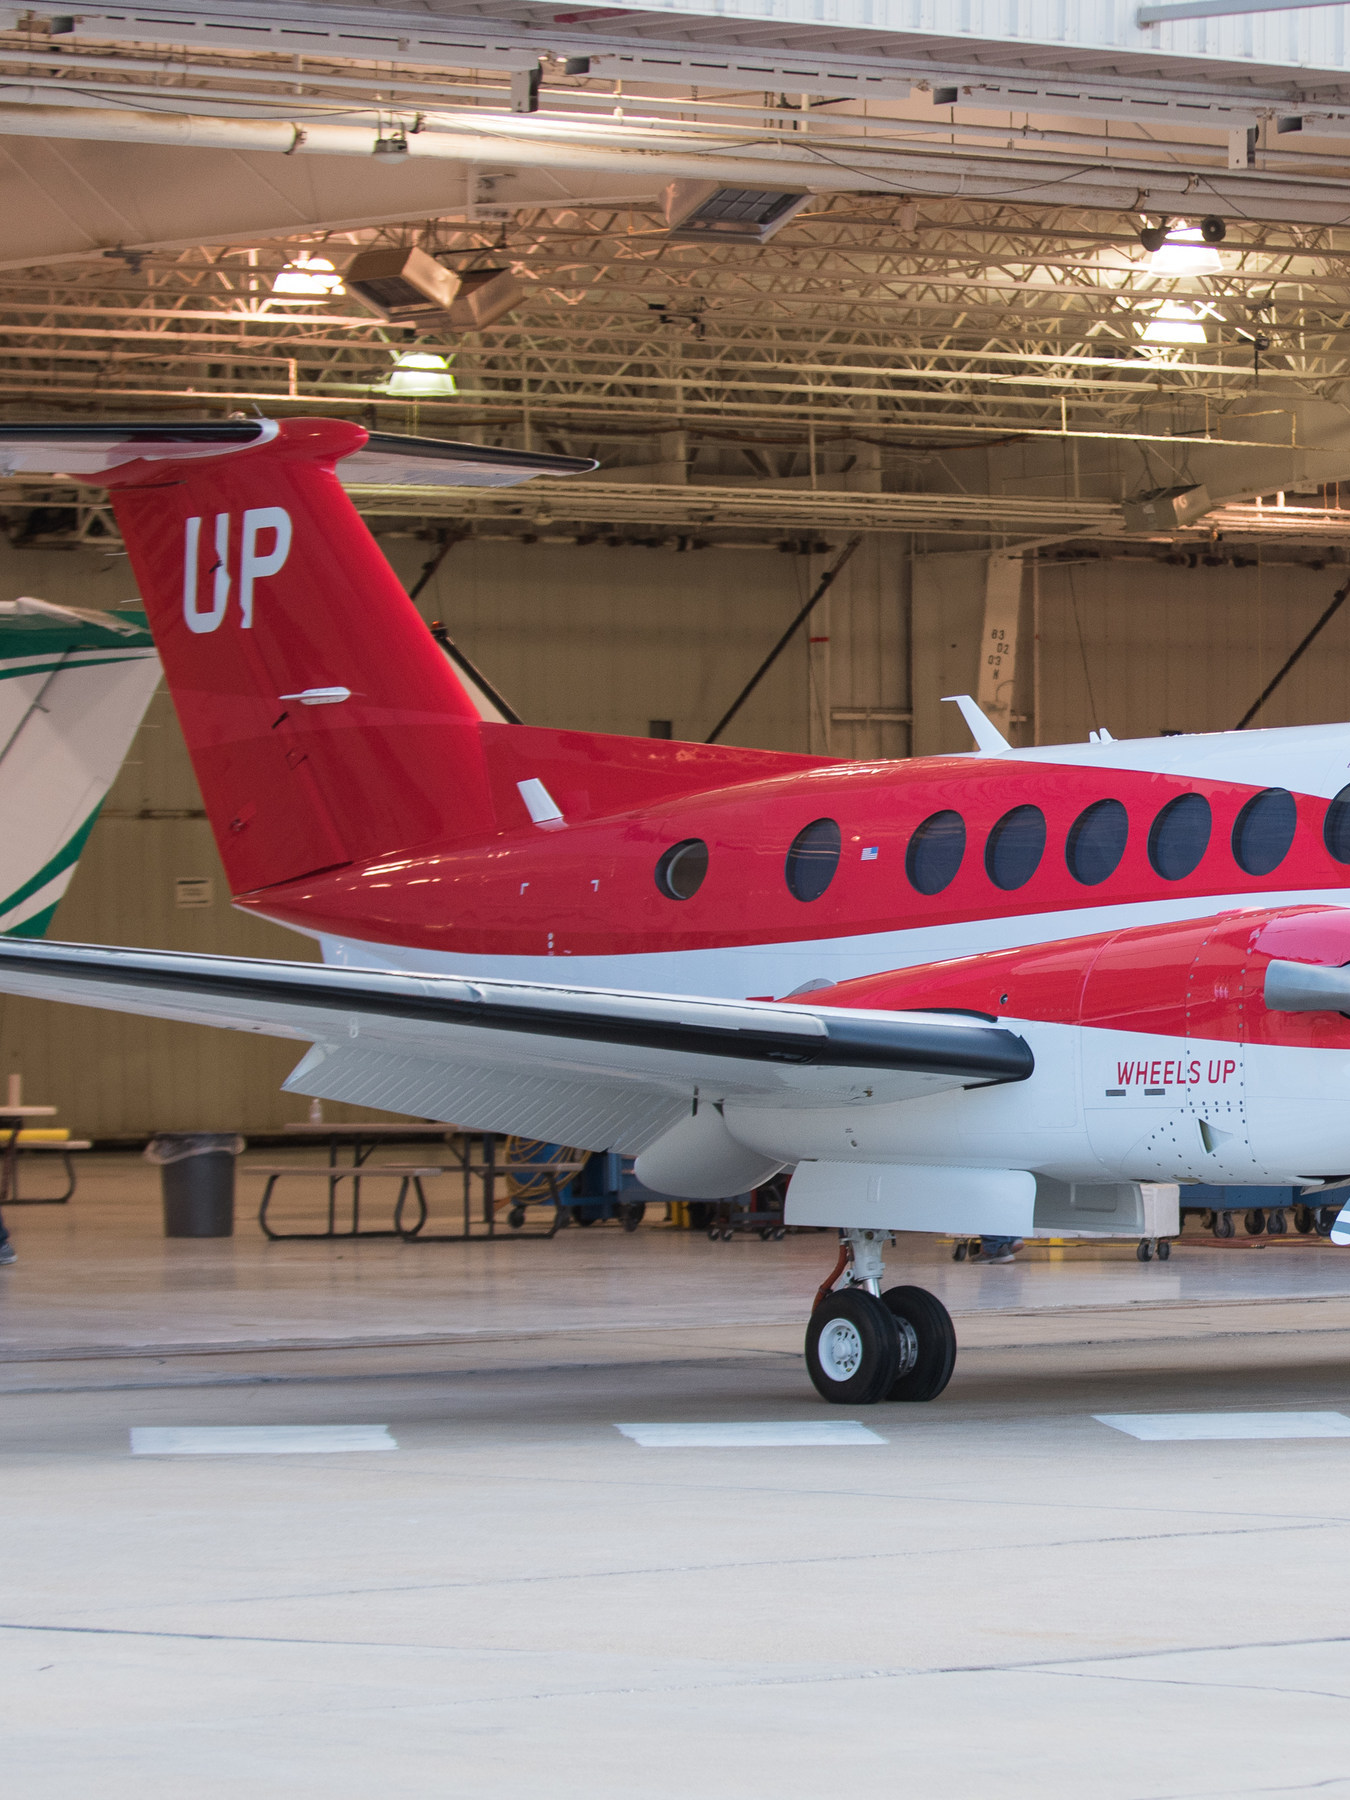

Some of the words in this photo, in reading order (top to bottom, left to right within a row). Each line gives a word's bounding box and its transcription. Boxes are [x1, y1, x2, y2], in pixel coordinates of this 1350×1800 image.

[183, 506, 292, 634] UP
[1117, 1060, 1201, 1085] WHEELS
[1208, 1060, 1236, 1084] UP
